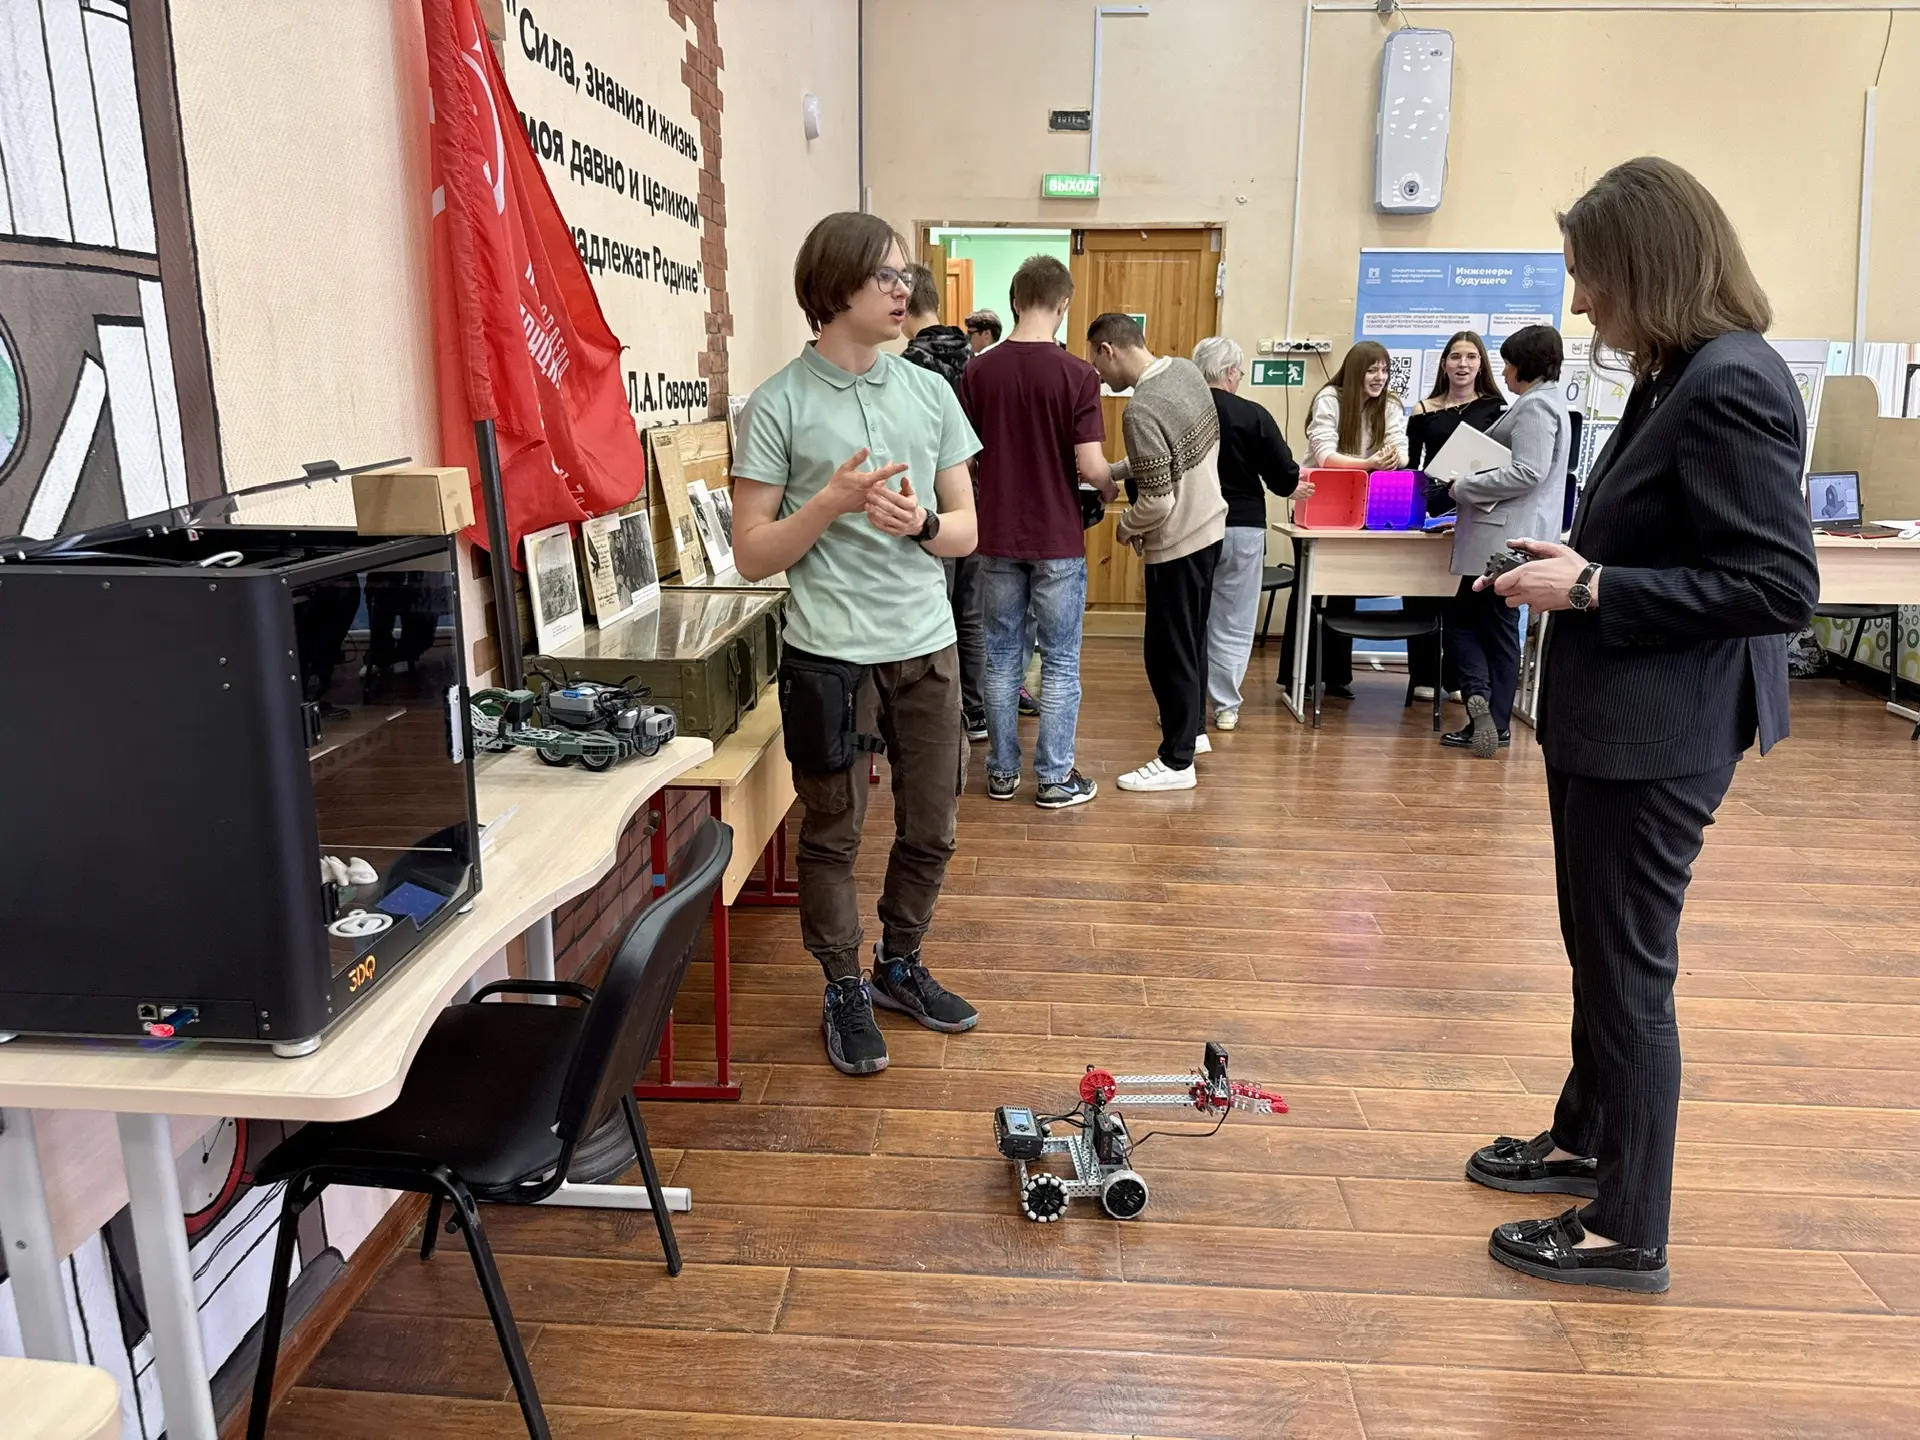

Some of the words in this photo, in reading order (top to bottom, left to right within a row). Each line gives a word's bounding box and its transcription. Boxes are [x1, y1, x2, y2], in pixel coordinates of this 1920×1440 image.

[584, 61, 645, 130] знания
[647, 104, 658, 138] и
[659, 113, 698, 163] жизнь
[570, 138, 625, 195] давно
[629, 167, 640, 202] и
[642, 174, 700, 229] целиком
[1048, 178, 1095, 194] ВЫХОД
[1456, 267, 1513, 276] Инженеры
[1455, 276, 1508, 286] будущего
